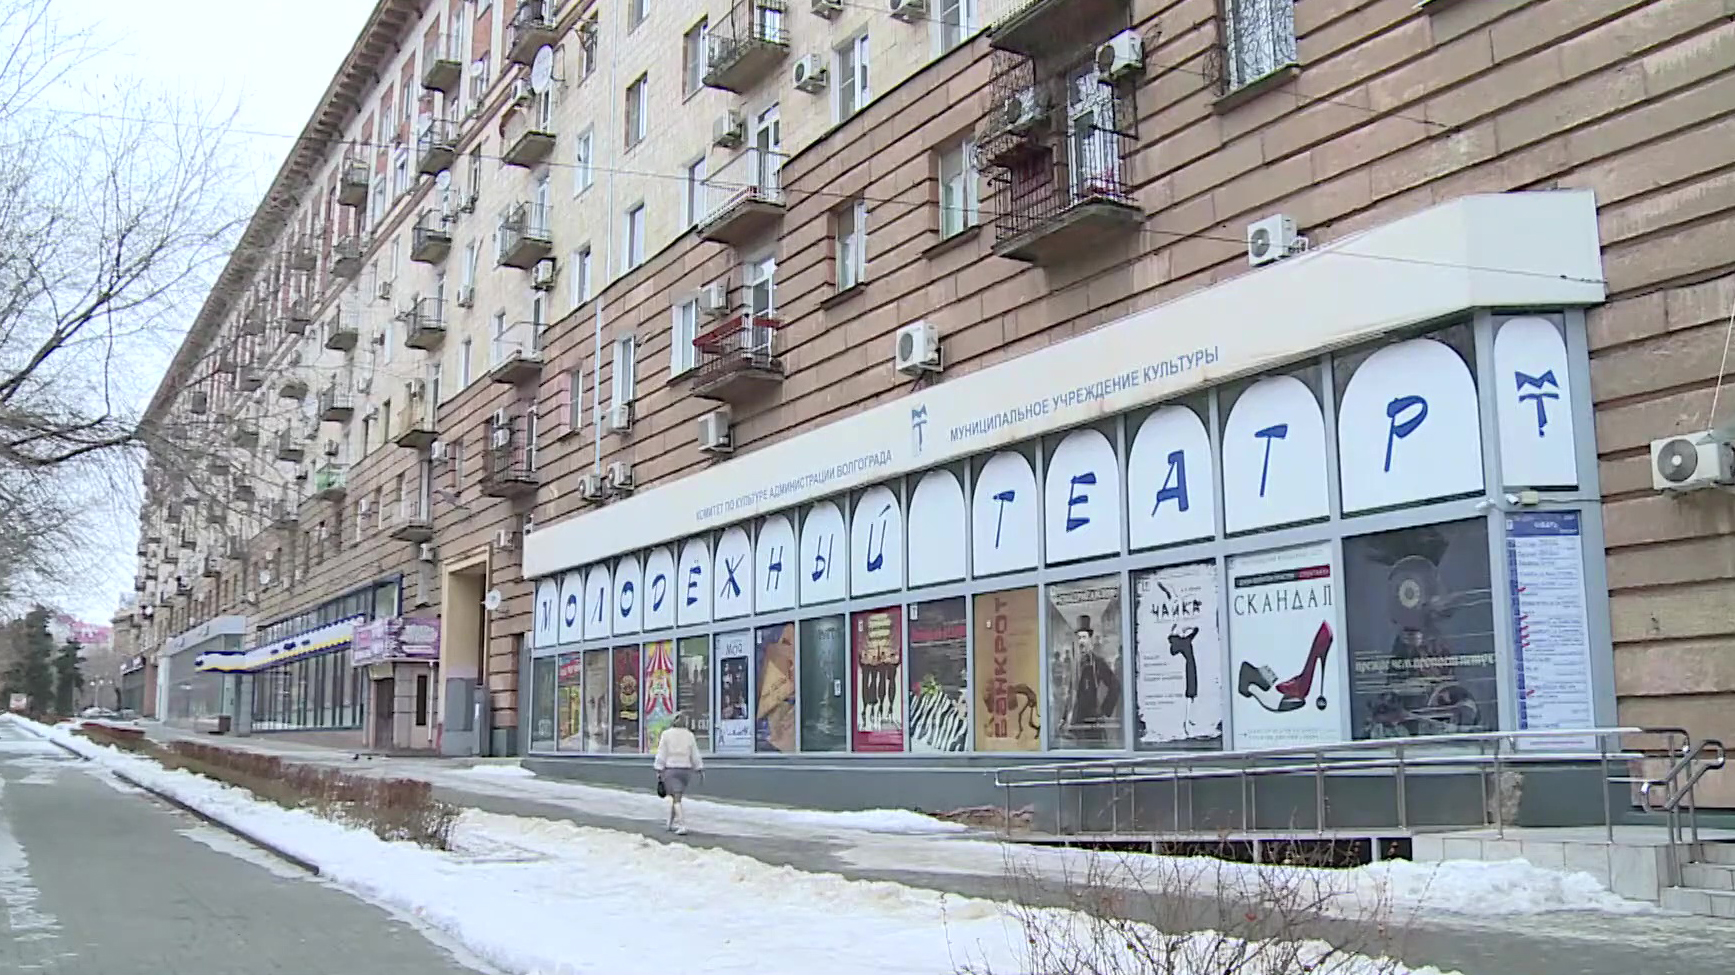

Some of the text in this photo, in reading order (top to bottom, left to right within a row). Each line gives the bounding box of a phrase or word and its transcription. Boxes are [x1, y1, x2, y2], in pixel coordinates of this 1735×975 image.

[950, 346, 1219, 442] МУНИЦИПАЛЬНОЕ УЧРЕЖДЕНИЕ КУЛЬТУРЫ
[696, 450, 892, 521] КОМИТЕТ ПО КУЛЬТУРЕ АДМИНИСТРАЦИИ ВОЛГОГРАДА
[993, 394, 1429, 550] ТЕАТР
[1151, 600, 1202, 617] ЧАЙКА
